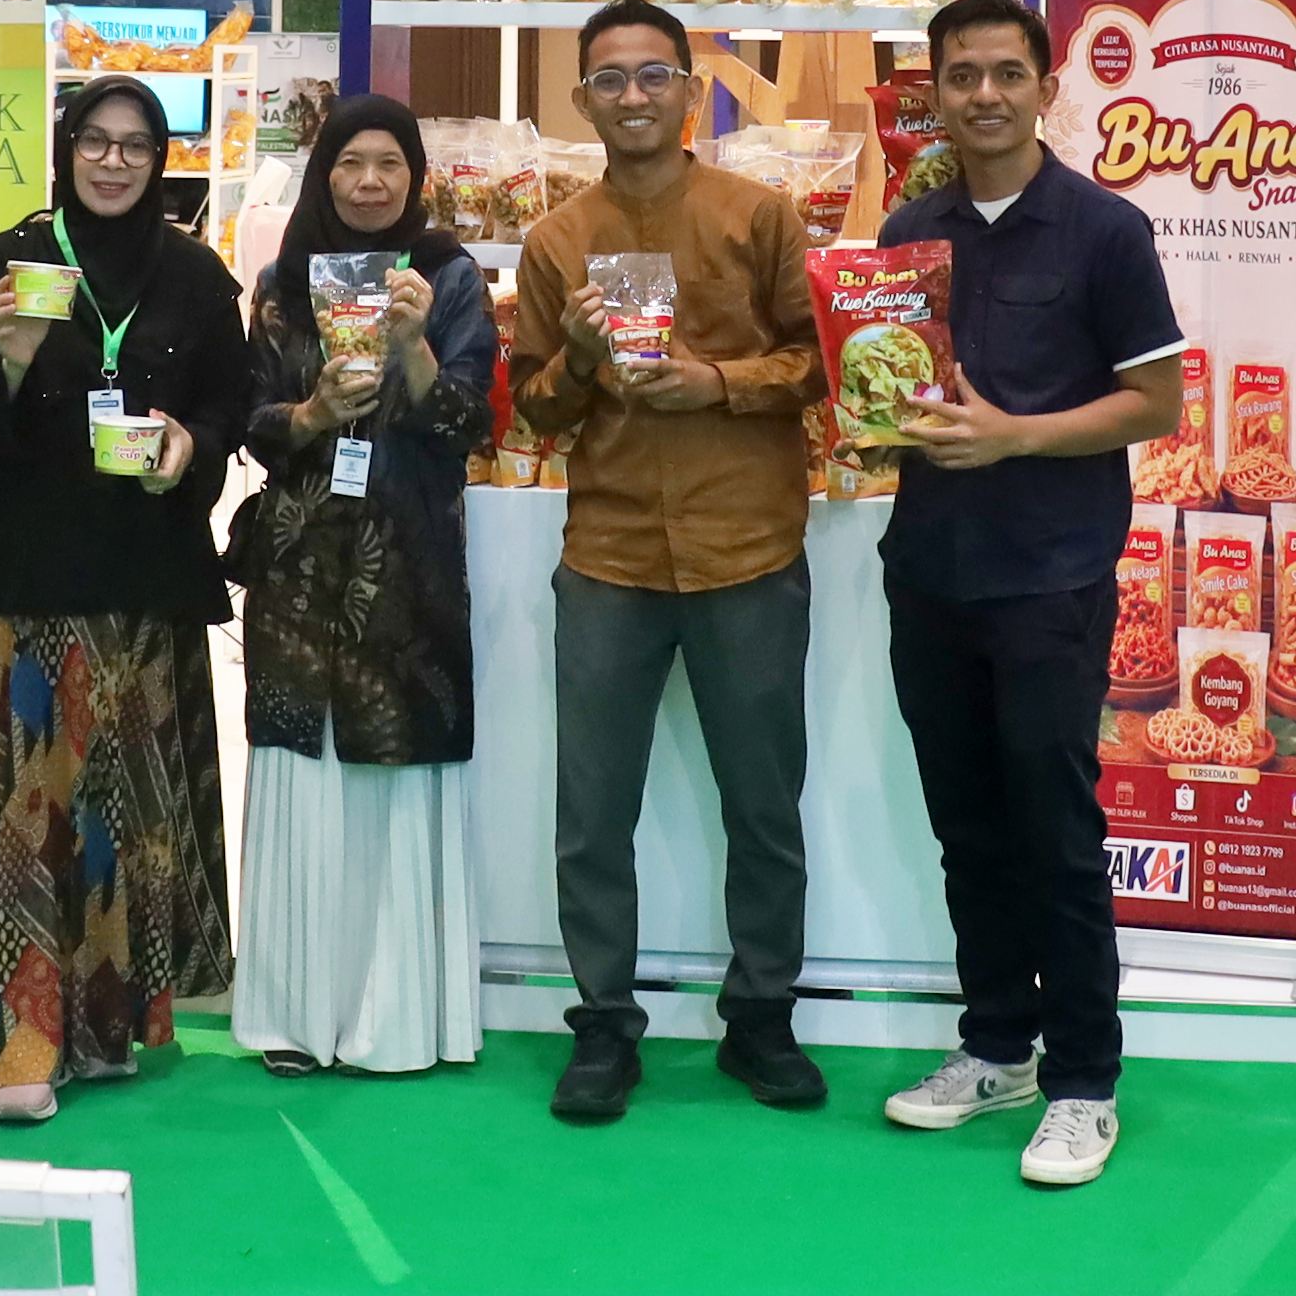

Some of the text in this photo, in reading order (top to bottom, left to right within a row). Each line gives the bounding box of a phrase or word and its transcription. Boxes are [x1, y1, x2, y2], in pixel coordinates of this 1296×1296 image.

[156, 24, 197, 40] MENJADI
[1102, 35, 1120, 45] LEZAT
[1164, 39, 1285, 60] CITA RASA NUSANTARA
[1214, 62, 1236, 76] Sejak
[1207, 77, 1242, 95] 1986
[1095, 99, 1193, 185] Bu
[1180, 218, 1227, 237] KHAS
[1186, 251, 1221, 262] HALAL
[1238, 252, 1281, 264] RENYAH
[836, 268, 919, 288] Bu Anas
[1239, 370, 1280, 385] Bu Anas
[1203, 544, 1247, 560] Bu Anas
[1130, 566, 1160, 581] Kelapa
[1199, 574, 1249, 593] Smile Cake
[1200, 675, 1244, 691] Kembang
[1204, 691, 1239, 711] Goyang
[1188, 767, 1239, 780] TERSEDIA DI
[1170, 811, 1198, 823] Shopee
[1224, 815, 1265, 828] TikTok Shop
[1218, 842, 1261, 857] 0812 1923
[1126, 844, 1185, 894] KAI
[1218, 862, 1266, 877] @buanas.id
[1217, 899, 1295, 915] @buanasofficial
